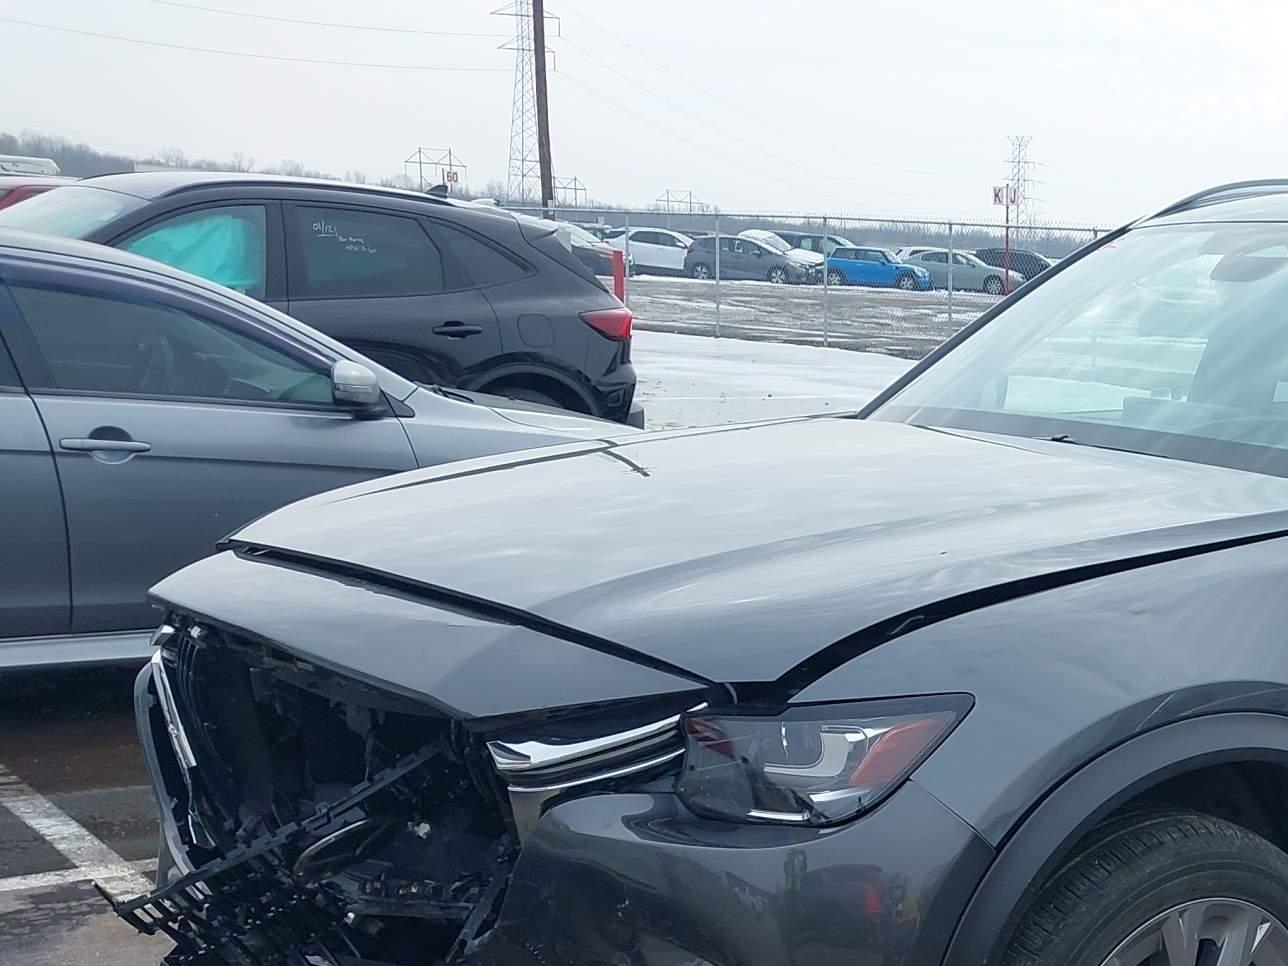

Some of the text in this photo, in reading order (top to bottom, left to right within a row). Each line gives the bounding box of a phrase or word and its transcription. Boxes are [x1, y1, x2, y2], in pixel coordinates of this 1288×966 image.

[446, 171, 458, 183] 60
[993, 187, 1002, 204] K
[1009, 188, 1017, 204] J
